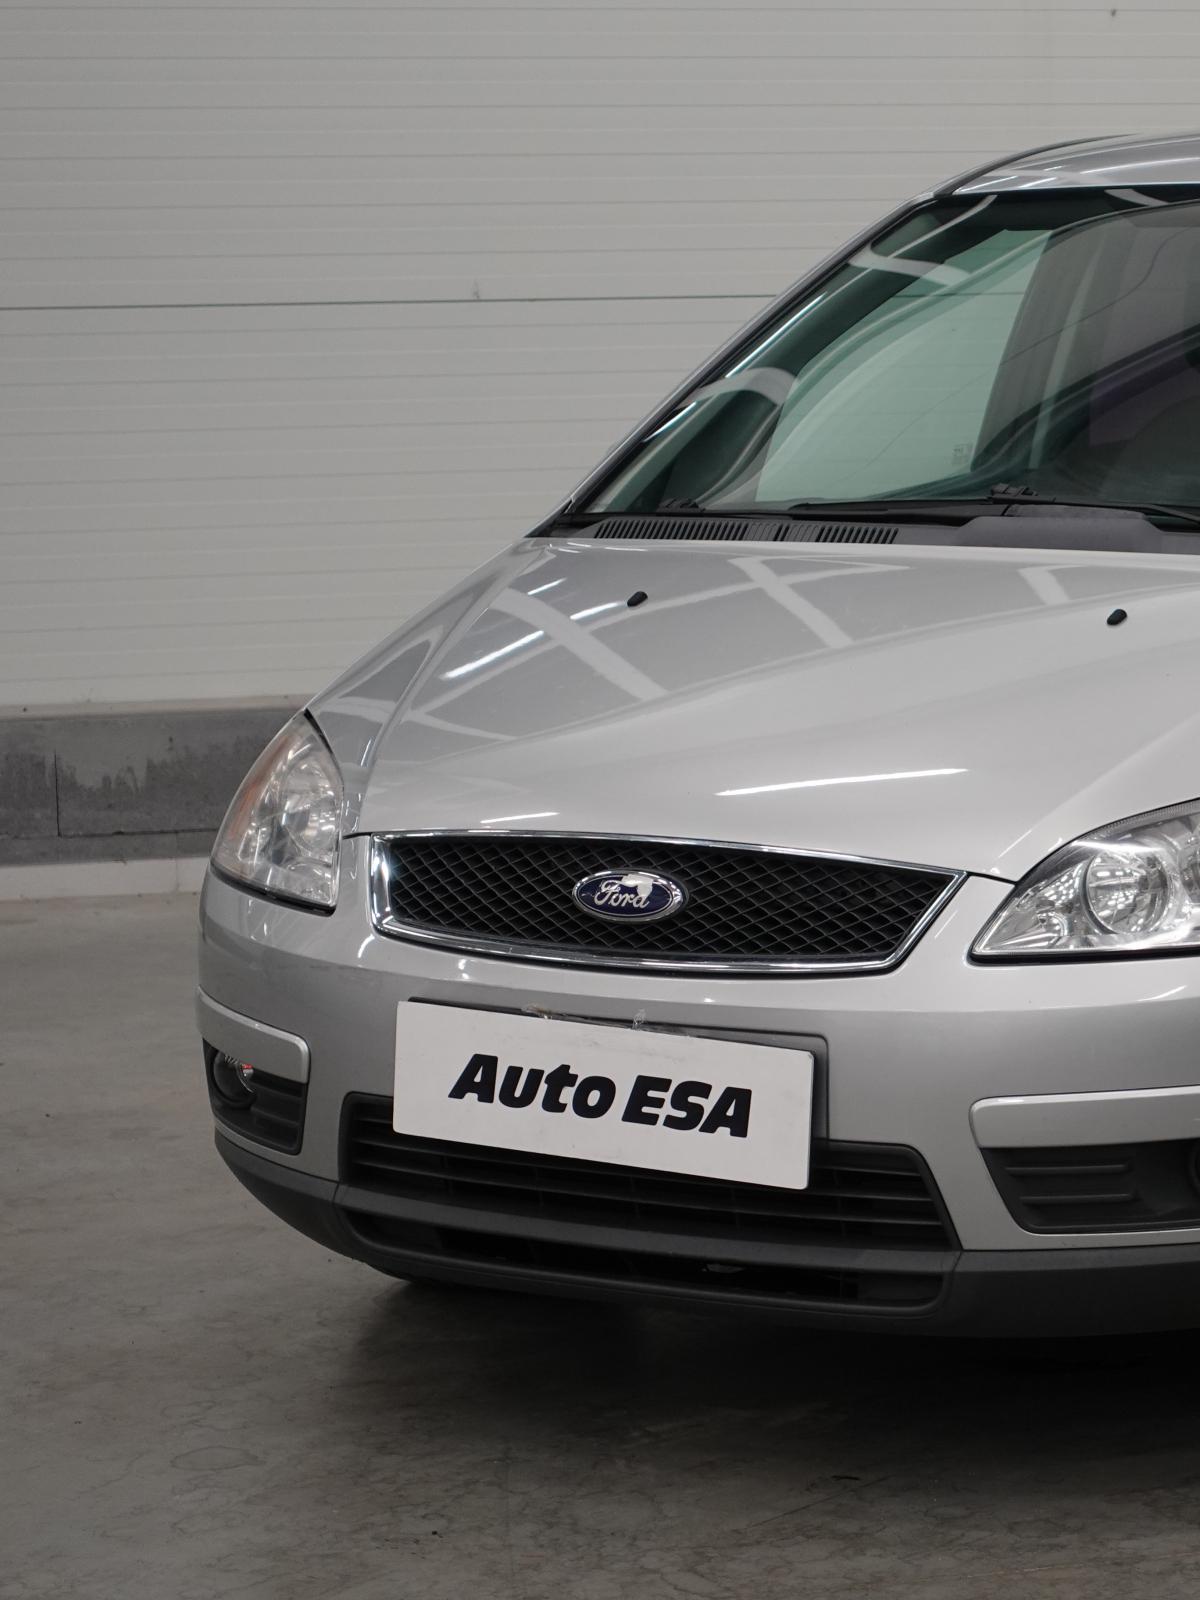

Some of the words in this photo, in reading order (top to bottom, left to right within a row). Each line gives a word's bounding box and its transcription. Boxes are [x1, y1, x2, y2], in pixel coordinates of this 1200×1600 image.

[594, 879, 650, 909] Ford
[447, 1053, 617, 1119] Auto
[621, 1074, 753, 1138] ESA
